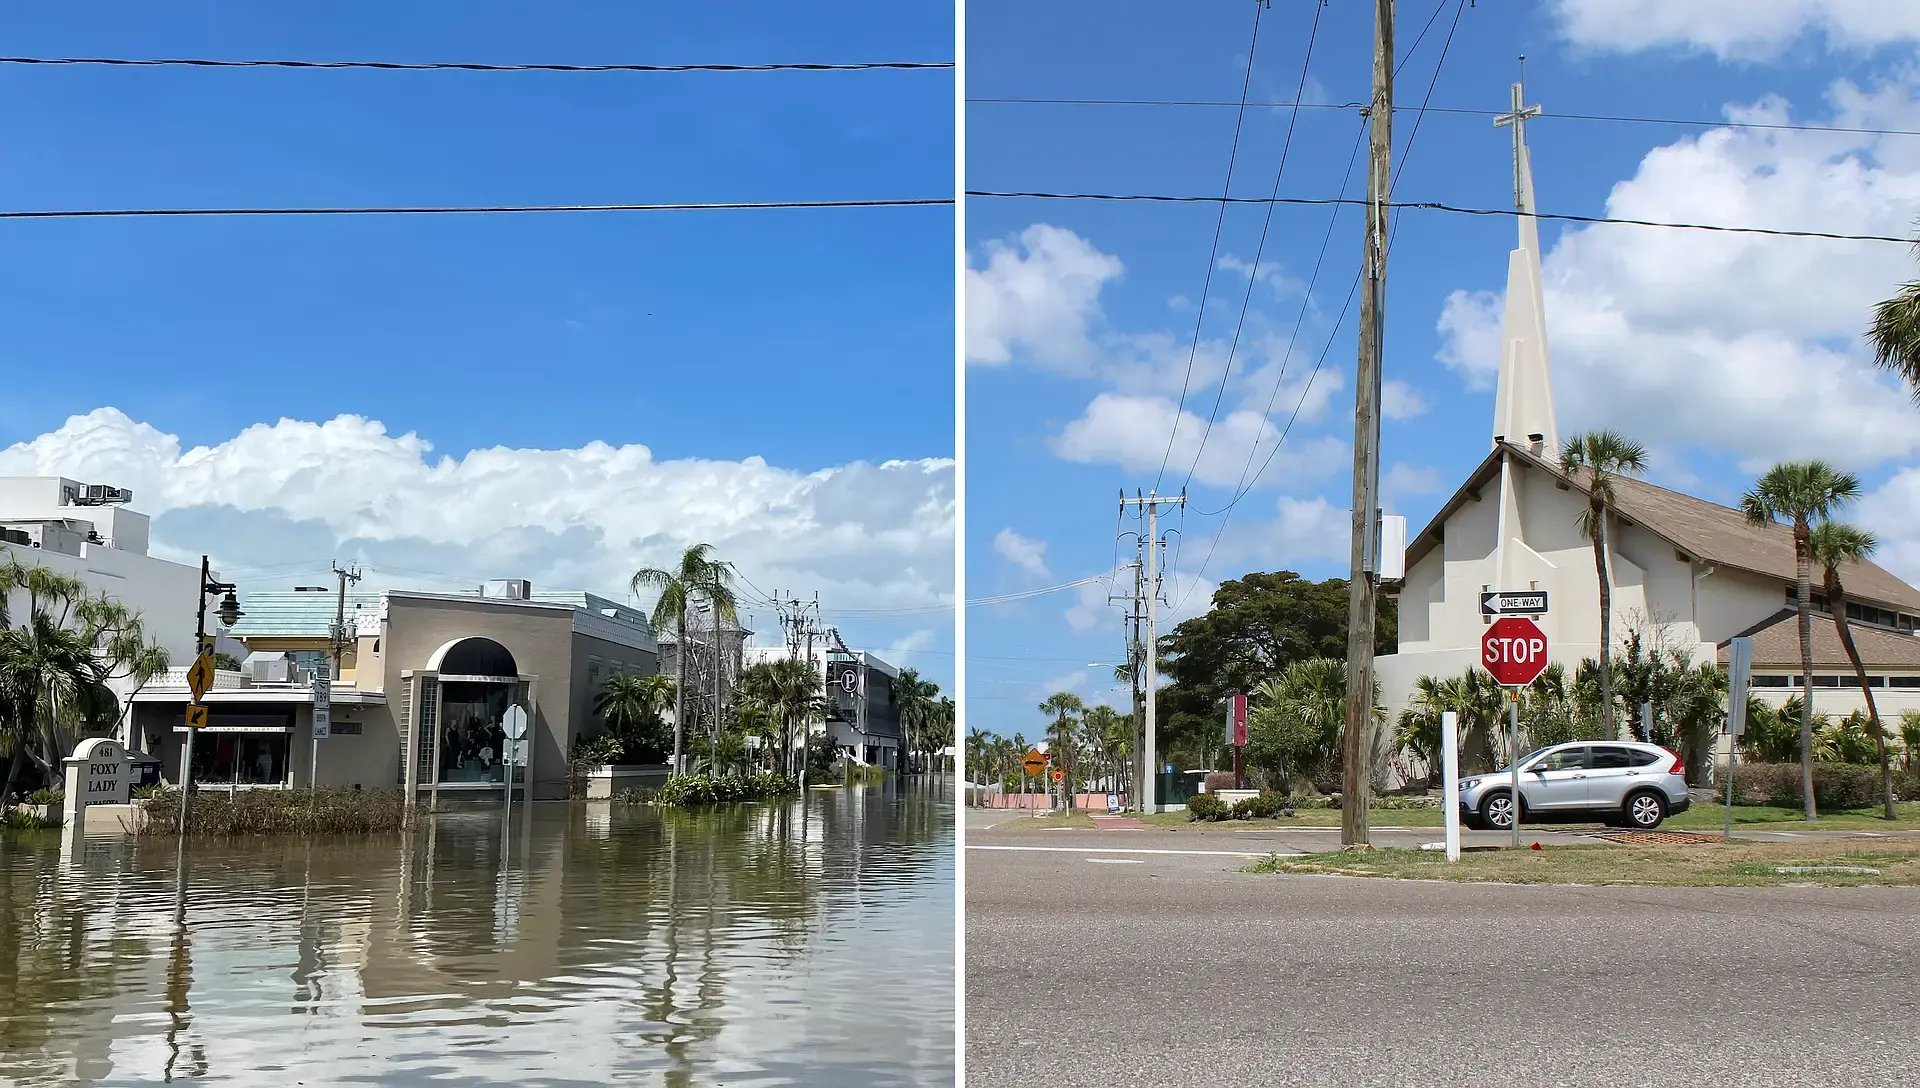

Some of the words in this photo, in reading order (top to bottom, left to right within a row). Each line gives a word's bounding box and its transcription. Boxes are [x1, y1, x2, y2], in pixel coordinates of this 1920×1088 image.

[1500, 598, 1519, 608] ONE
[1521, 597, 1541, 607] WAY
[1485, 637, 1544, 664] STOP
[844, 673, 856, 690] P
[99, 747, 113, 757] 481
[90, 763, 119, 775] FOXY
[88, 780, 118, 792] LADY
